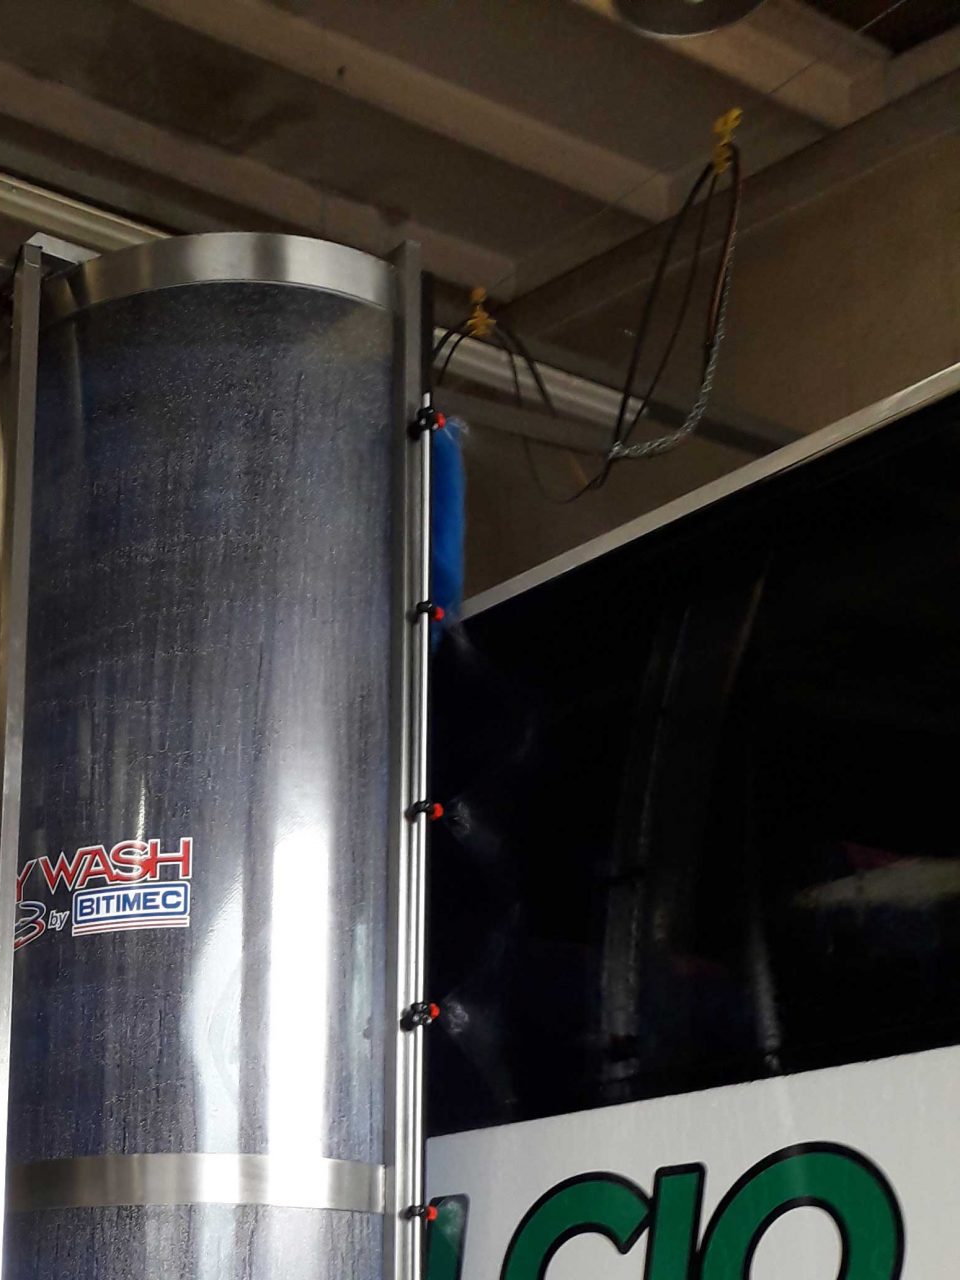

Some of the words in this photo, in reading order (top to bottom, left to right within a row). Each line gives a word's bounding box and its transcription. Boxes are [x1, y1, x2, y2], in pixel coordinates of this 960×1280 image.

[40, 837, 193, 895] WASH
[48, 909, 70, 931] by
[78, 890, 182, 918] BITIMEC
